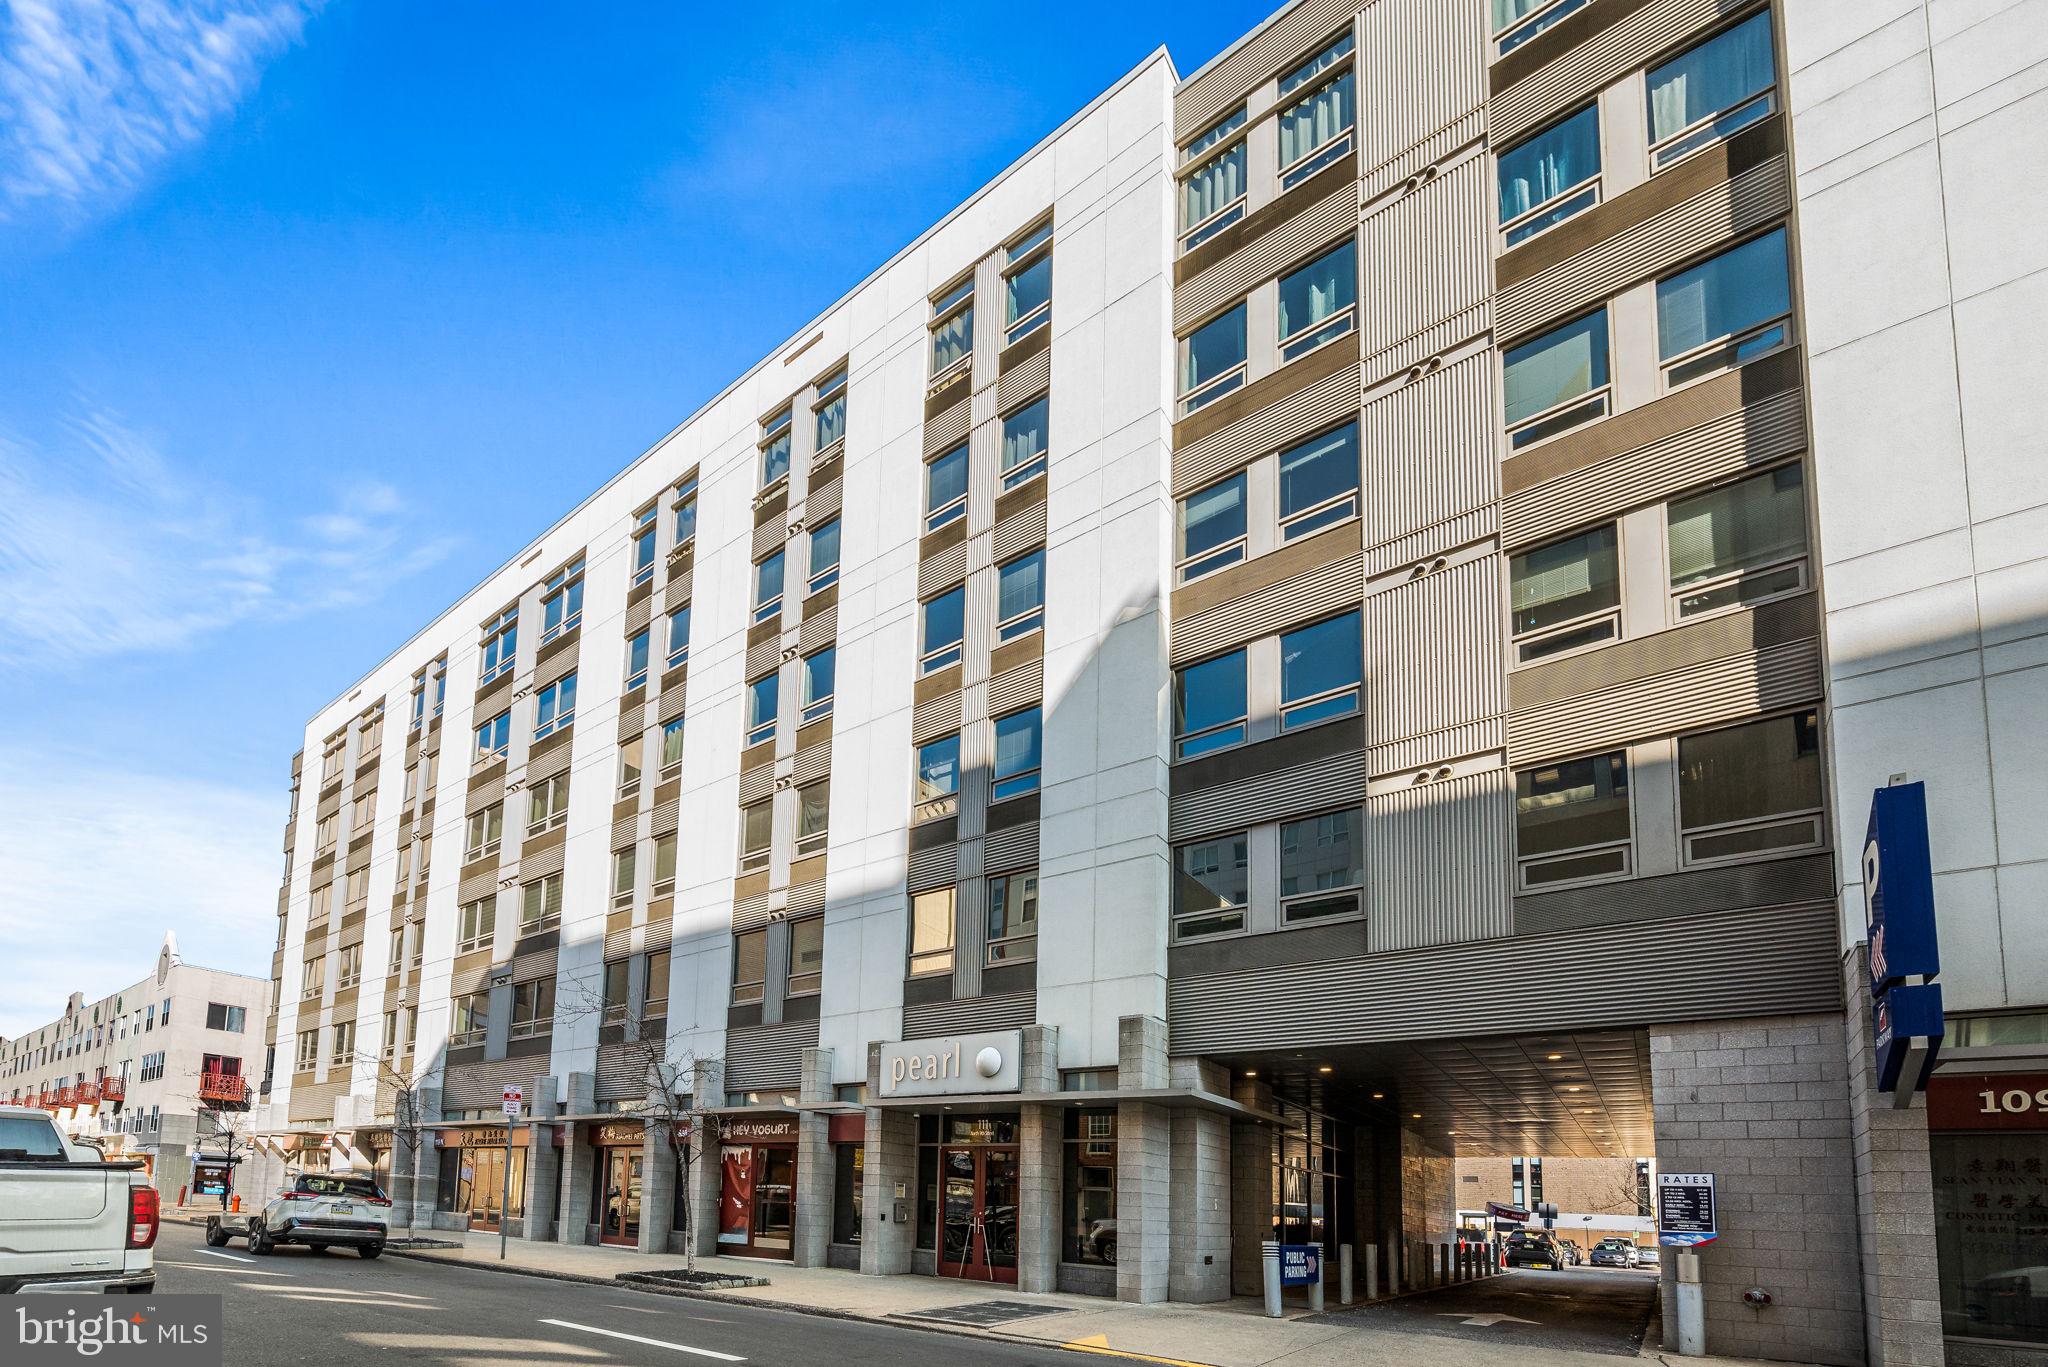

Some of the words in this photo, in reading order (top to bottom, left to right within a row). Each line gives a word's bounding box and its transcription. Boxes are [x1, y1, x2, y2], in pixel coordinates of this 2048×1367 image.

[1863, 839, 1880, 929] P
[891, 1041, 961, 1091] pearl
[733, 1124, 750, 1136] HEY
[752, 1123, 790, 1136] YOGURT
[1664, 1176, 1708, 1184] RATES
[1286, 1251, 1306, 1264] PUBLIC
[1285, 1265, 1307, 1278] PARKING
